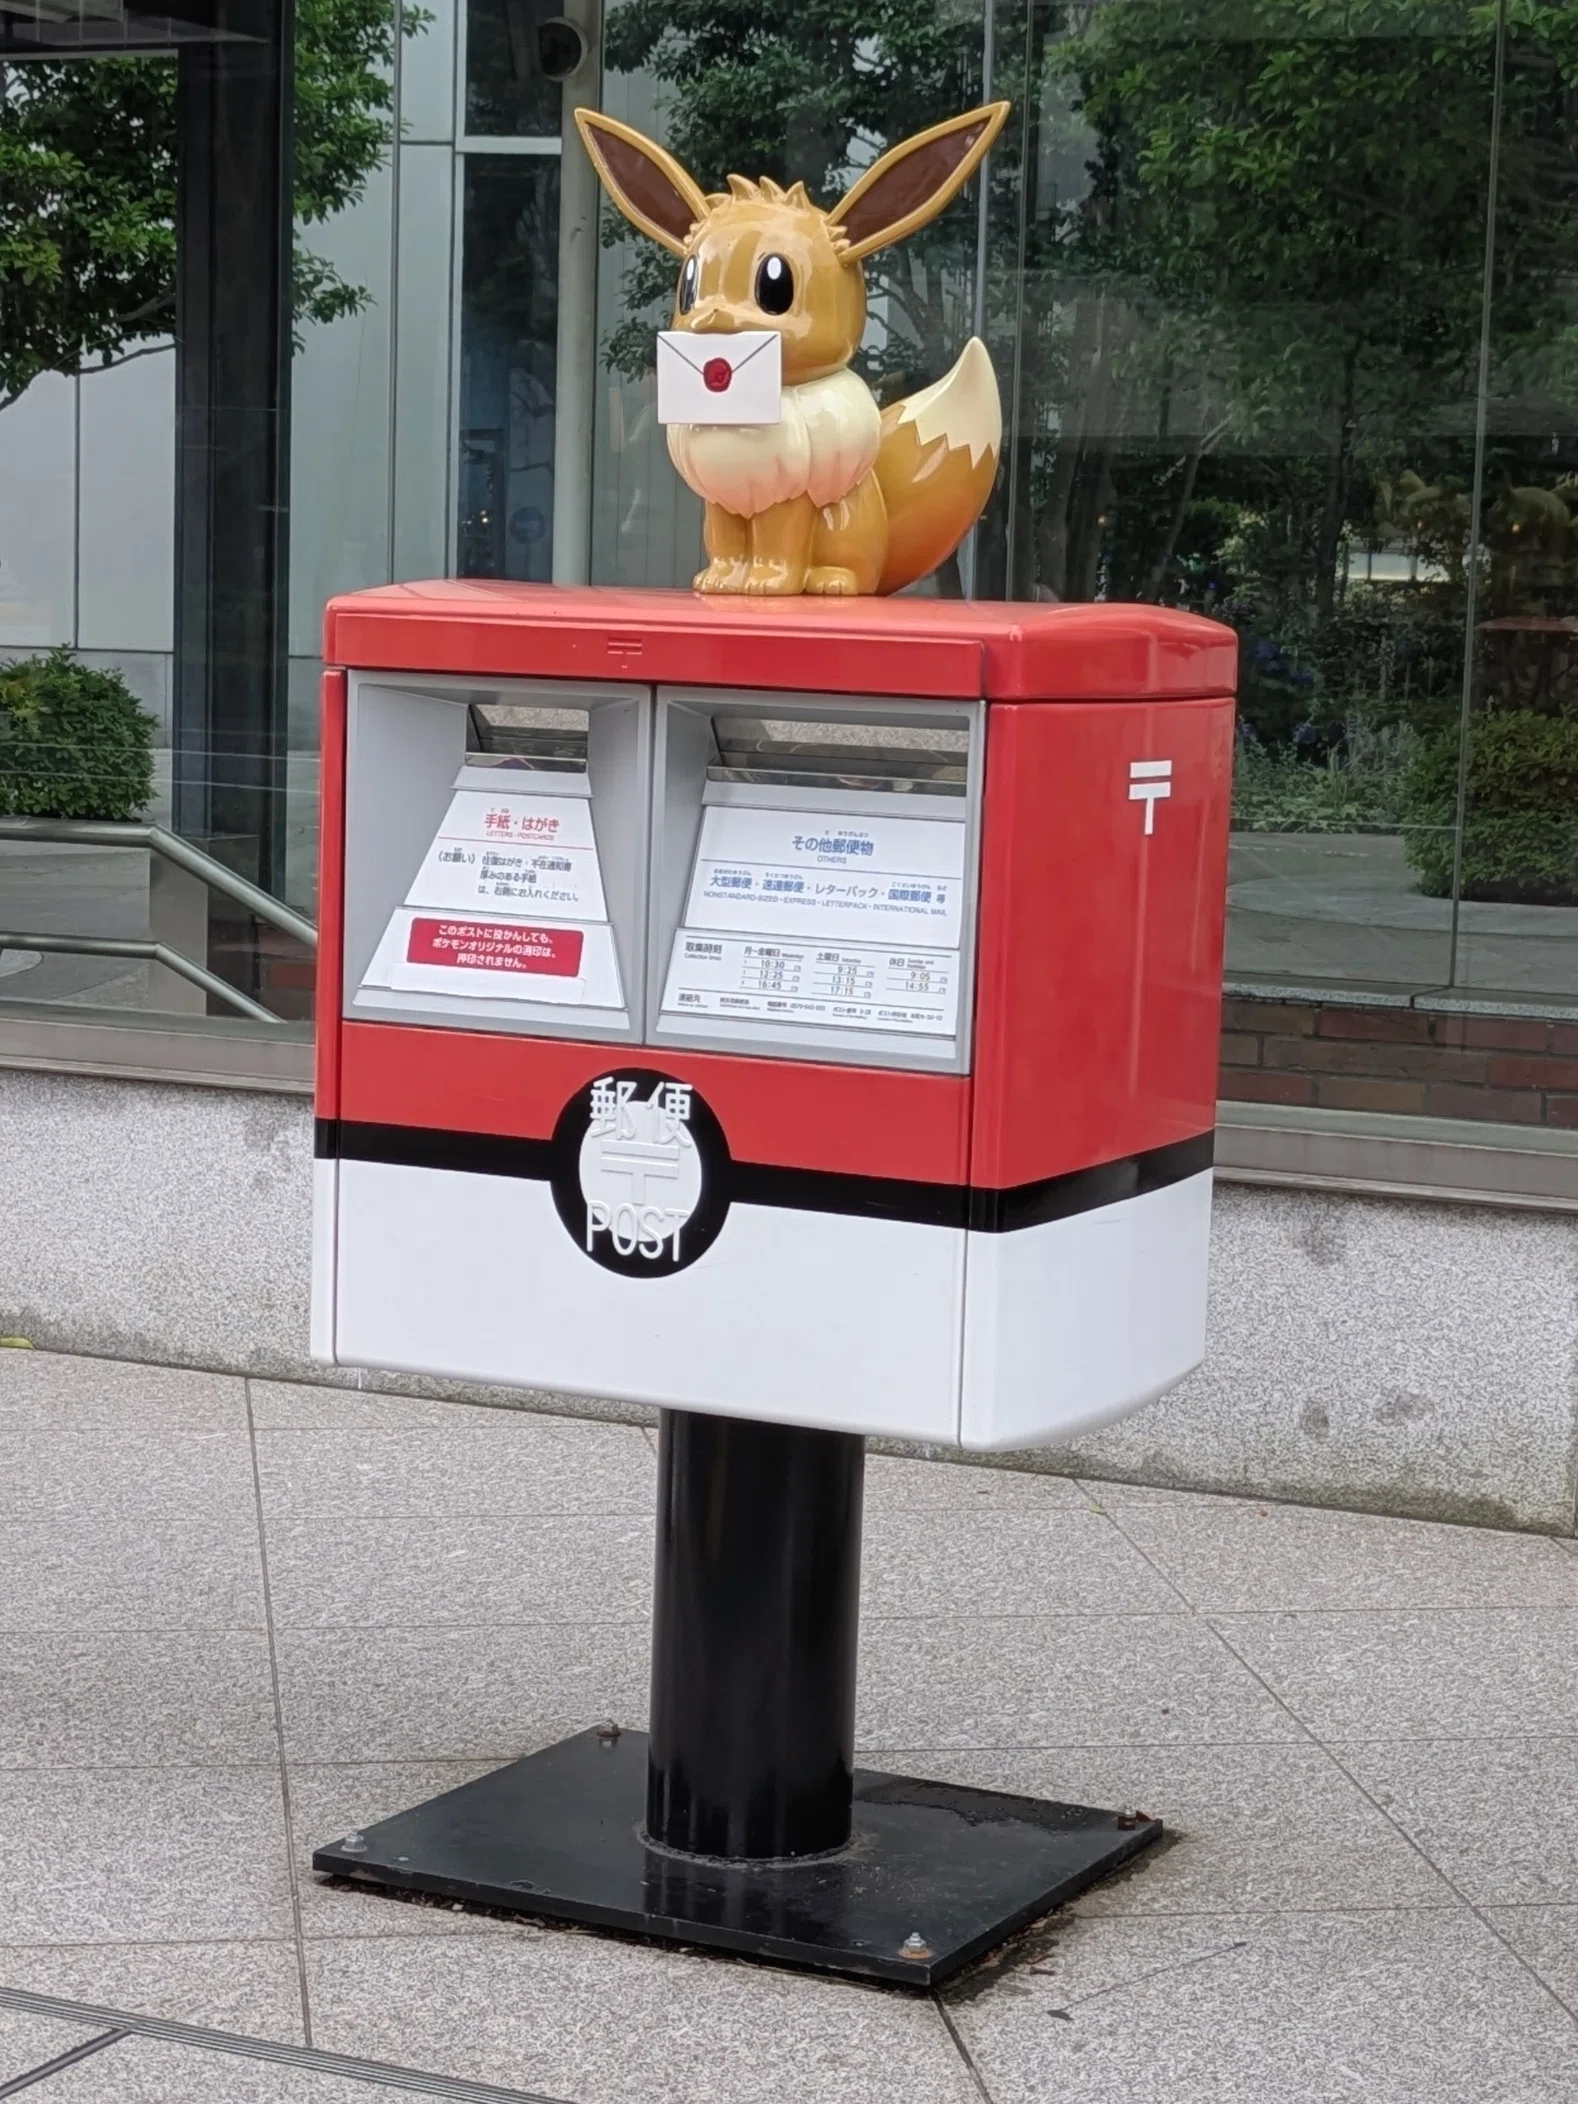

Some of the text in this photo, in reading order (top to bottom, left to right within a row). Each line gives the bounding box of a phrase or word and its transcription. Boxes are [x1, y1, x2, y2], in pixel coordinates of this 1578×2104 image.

[484, 813, 559, 832] 手紙・はがき
[792, 836, 874, 856] その他郵便物
[817, 855, 847, 864] OTHERS
[439, 924, 553, 944] このポストに投かんしても、
[457, 953, 527, 969] 押印されません。
[816, 952, 840, 961] 土曜日
[761, 960, 785, 969] 10:30
[760, 970, 783, 979] 12:25
[837, 966, 857, 975] 9:25
[911, 971, 931, 981] 9:05
[758, 980, 781, 989] 16:45
[830, 986, 854, 995] 17:15
[589, 1076, 693, 1148] 郵便
[586, 1200, 690, 1262] POST
